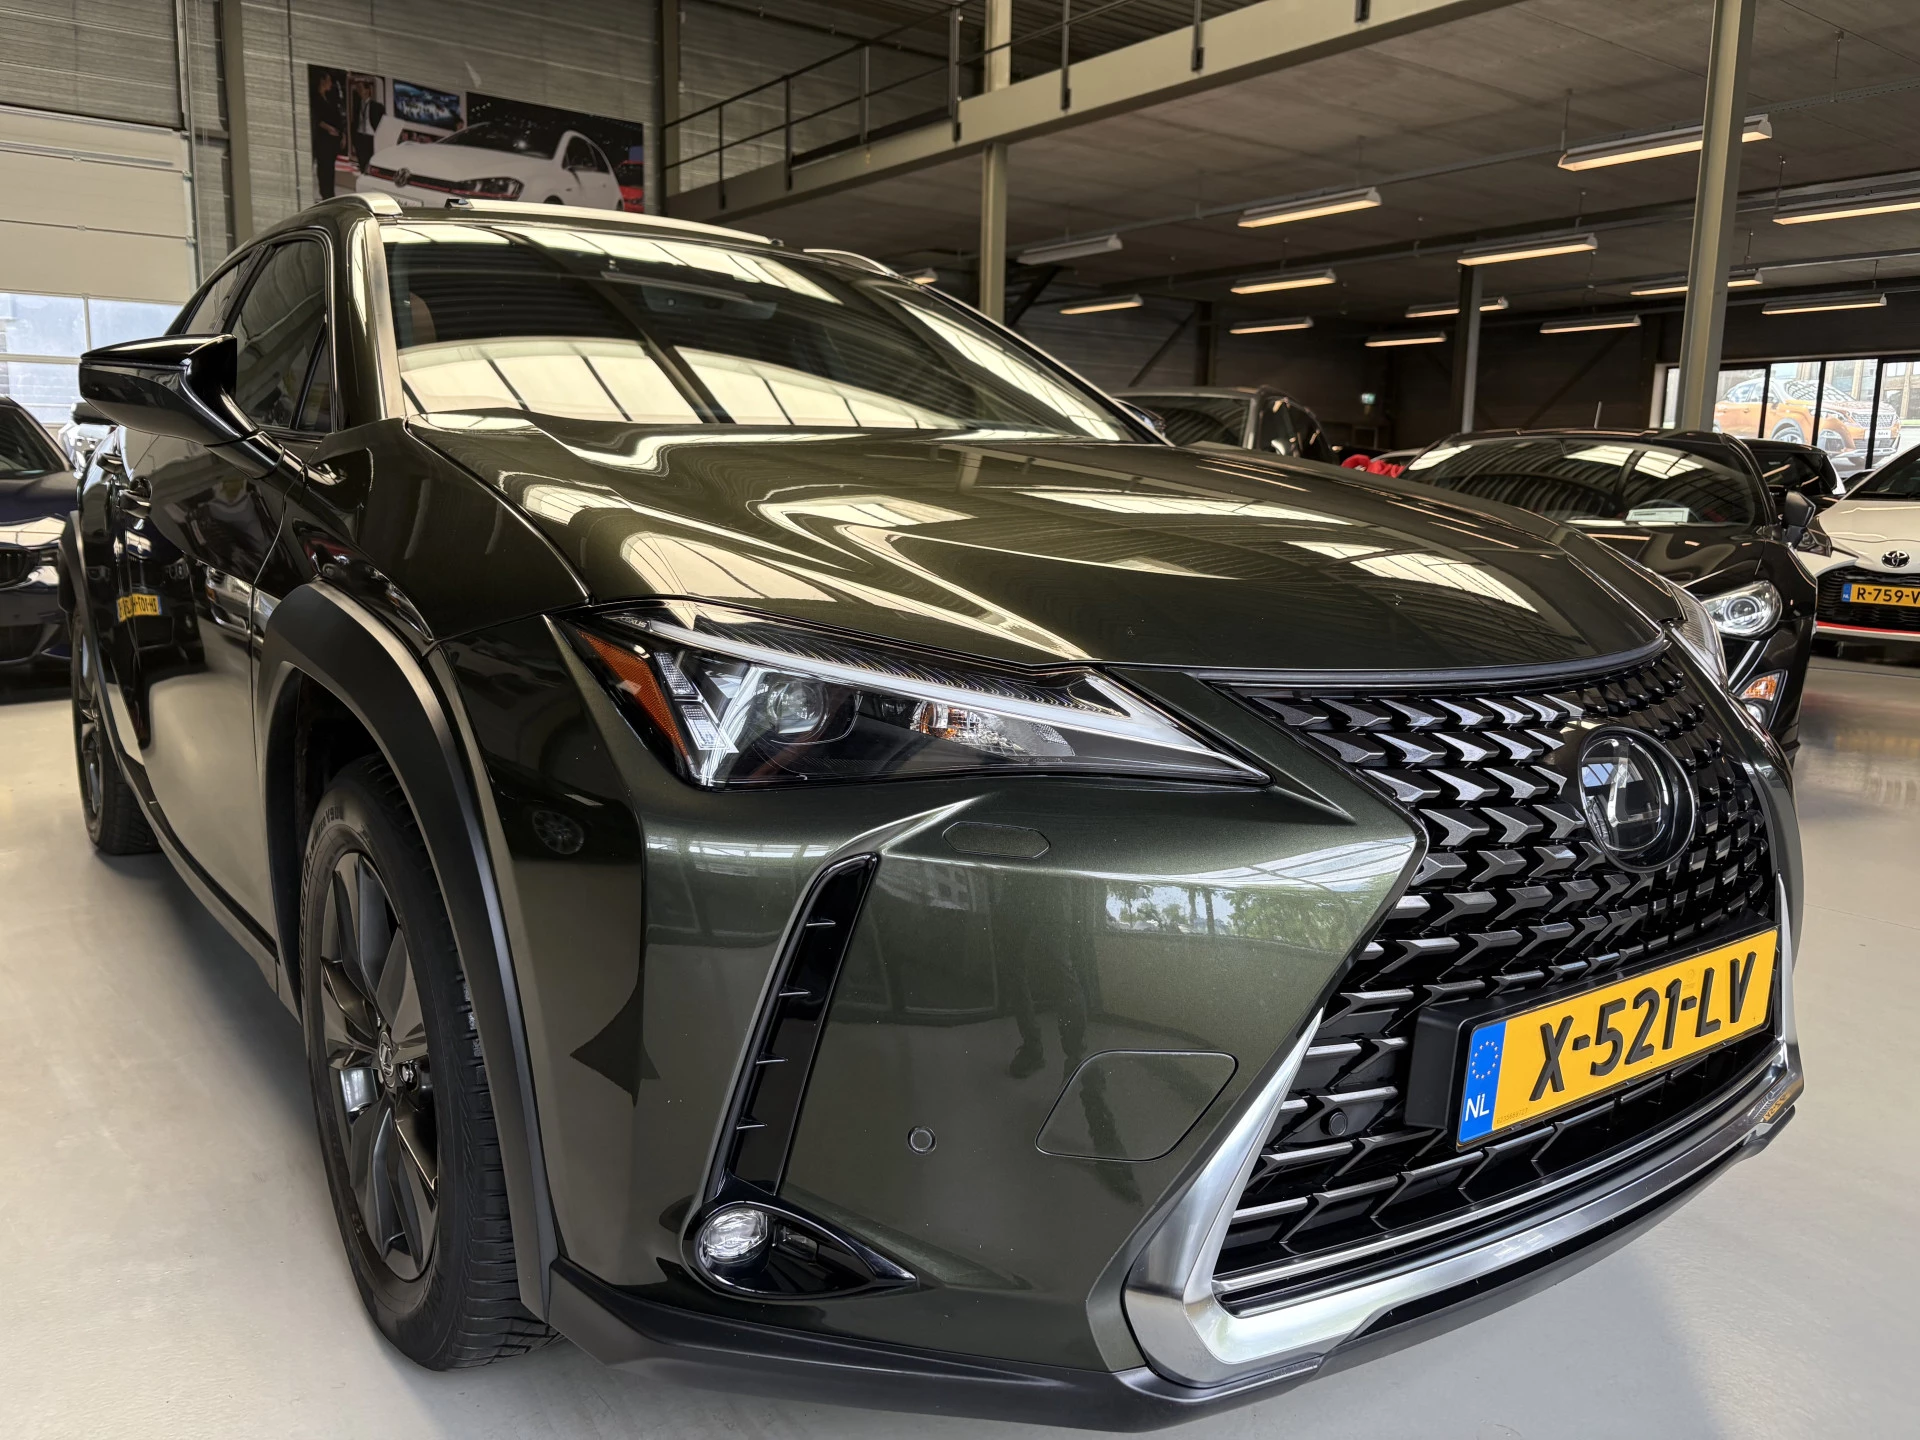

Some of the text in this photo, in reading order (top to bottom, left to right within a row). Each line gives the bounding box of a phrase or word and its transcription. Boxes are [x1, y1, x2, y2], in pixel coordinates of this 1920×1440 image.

[1856, 586, 1920, 604] R-759-V
[1528, 951, 1757, 1101] X-521-LV
[1464, 1093, 1490, 1121] NL
